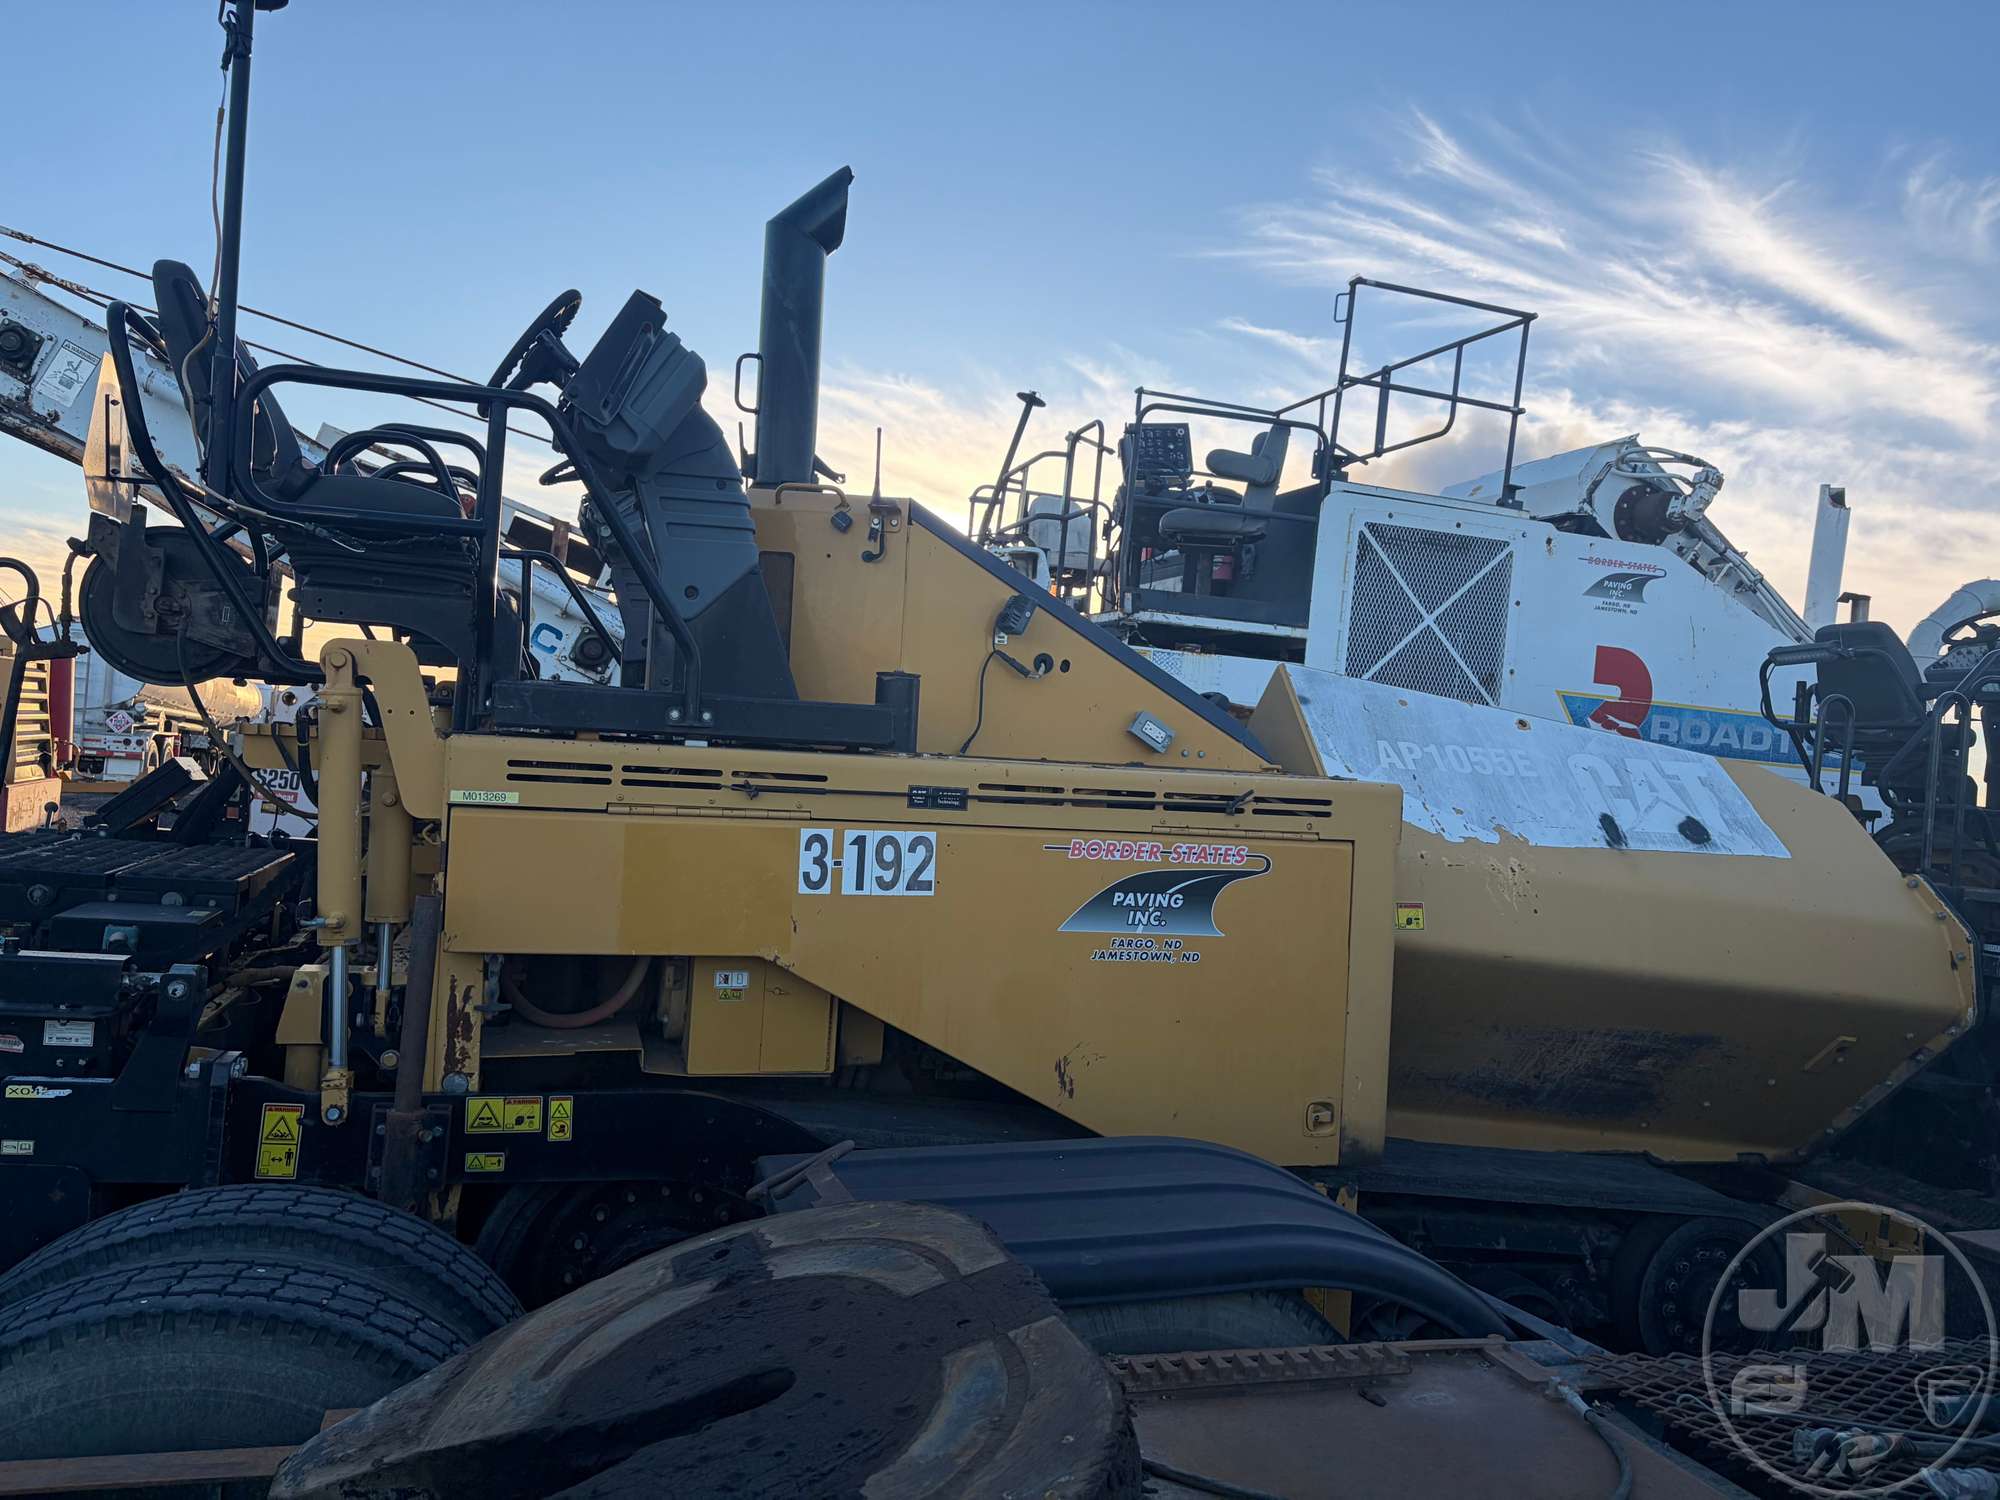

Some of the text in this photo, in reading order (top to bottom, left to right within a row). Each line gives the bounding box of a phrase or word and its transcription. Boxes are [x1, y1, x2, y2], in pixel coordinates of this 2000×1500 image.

[1588, 556, 1657, 573] BORDER STATES
[1603, 580, 1632, 590] PAVING
[1377, 740, 1539, 778] AP1055E
[256, 769, 300, 790] S250
[462, 791, 507, 802] M013269
[1068, 839, 1248, 865] BORDER STATES
[802, 833, 934, 891] 3-192
[1112, 892, 1184, 908] PAVING
[1127, 910, 1167, 927] INC.
[1110, 938, 1183, 951] FARGO, ND
[1091, 951, 1200, 963] JAMESTOWN, ND
